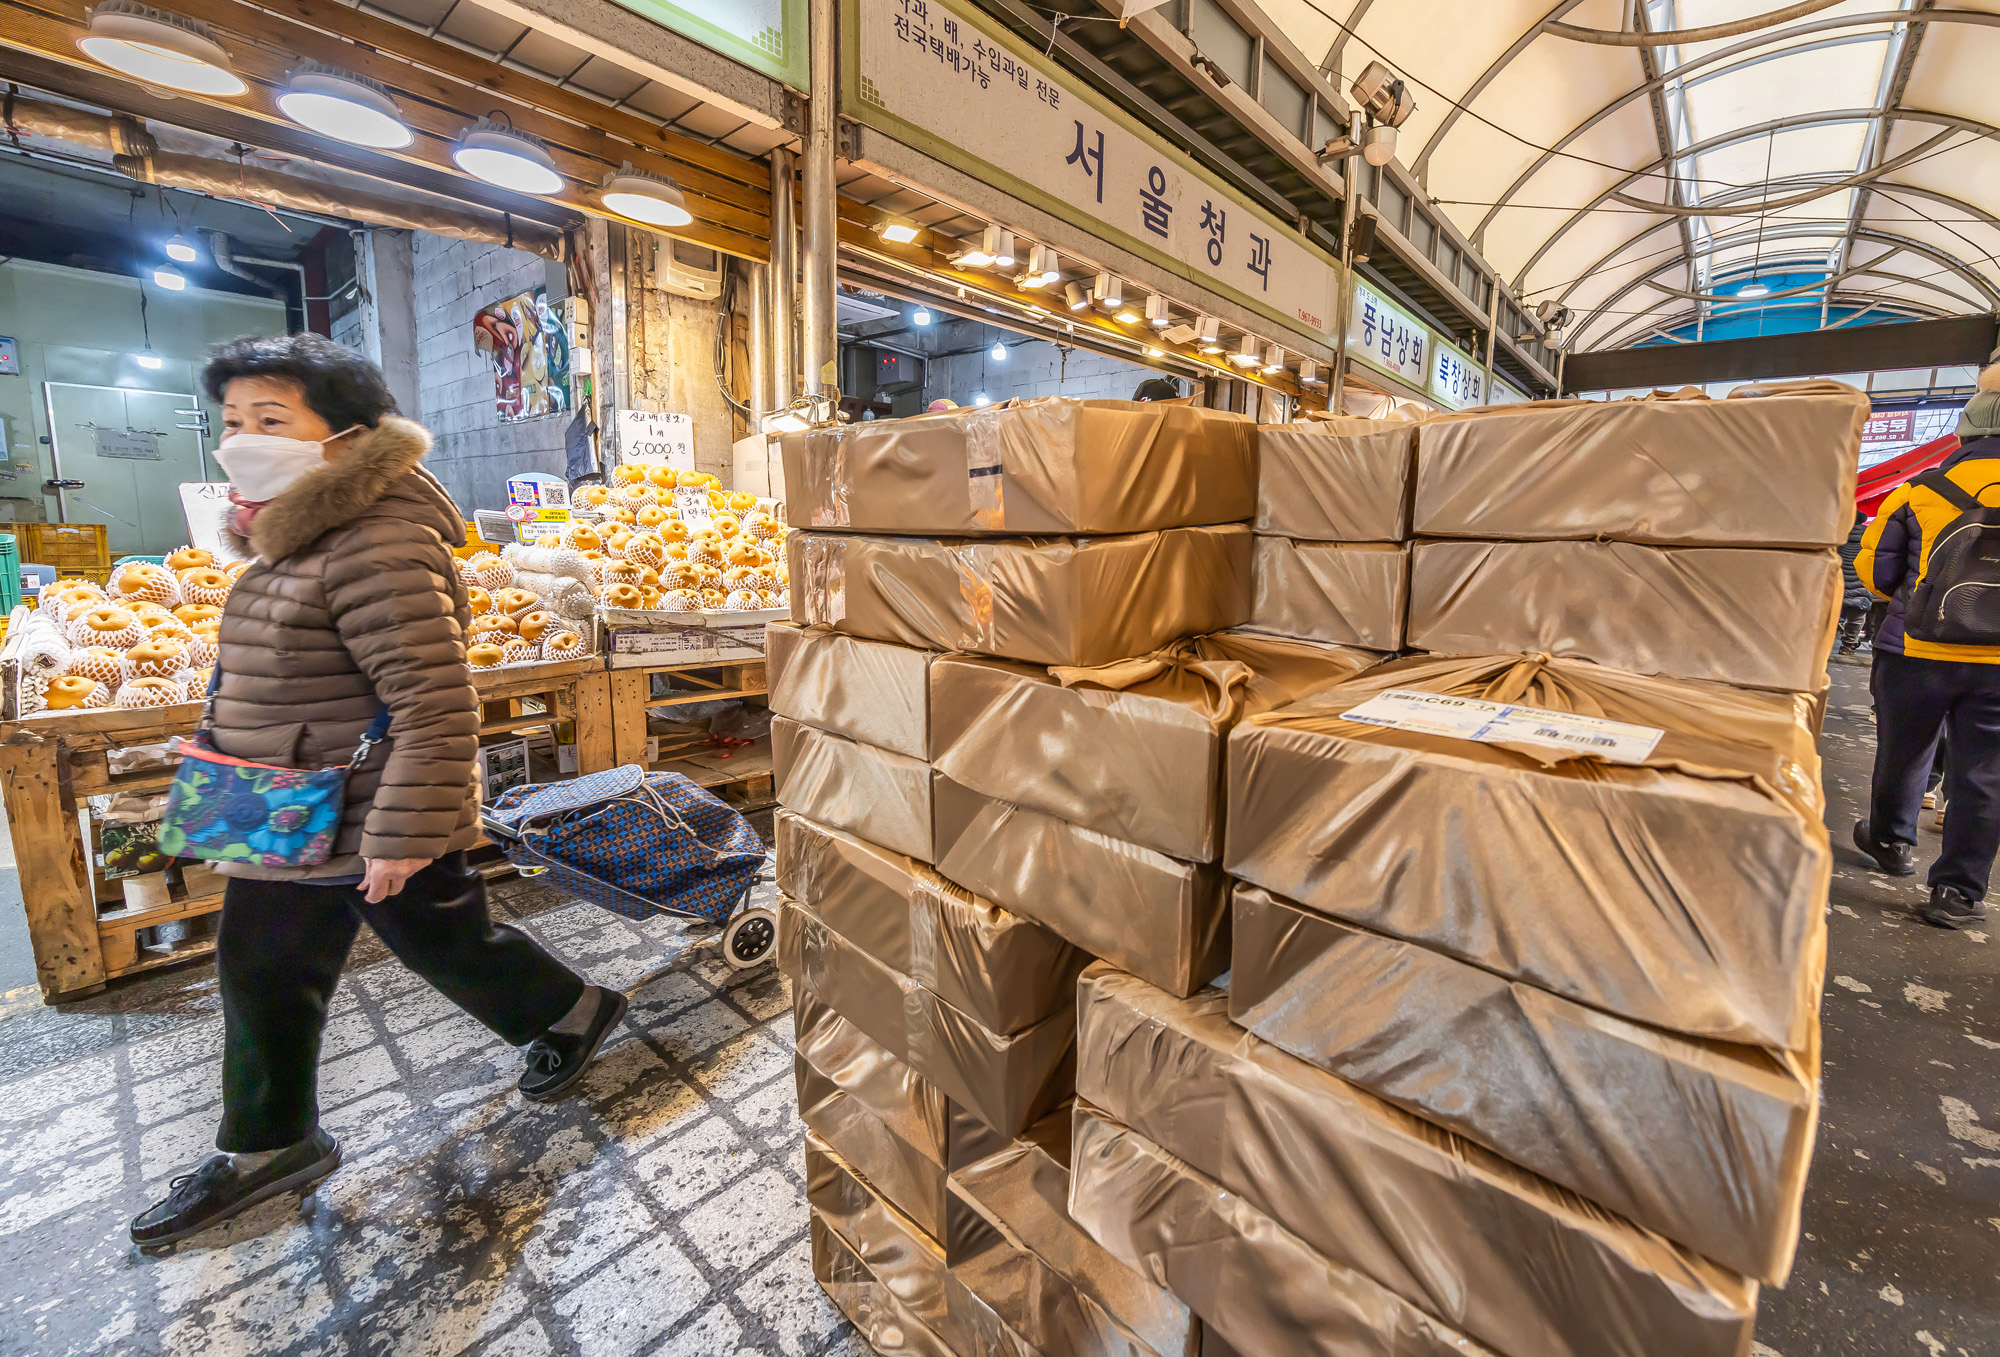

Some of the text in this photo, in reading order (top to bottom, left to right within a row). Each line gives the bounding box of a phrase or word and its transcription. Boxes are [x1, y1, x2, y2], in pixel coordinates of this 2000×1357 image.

[894, 13, 991, 89] 전국택배가능
[972, 38, 1028, 90] 수입과일
[1035, 78, 1060, 110] 전문
[1065, 119, 1272, 292] 서울청과
[1362, 302, 1423, 375] 풍남상회
[1439, 353, 1481, 405] 북창상회
[197, 484, 228, 499] 신고
